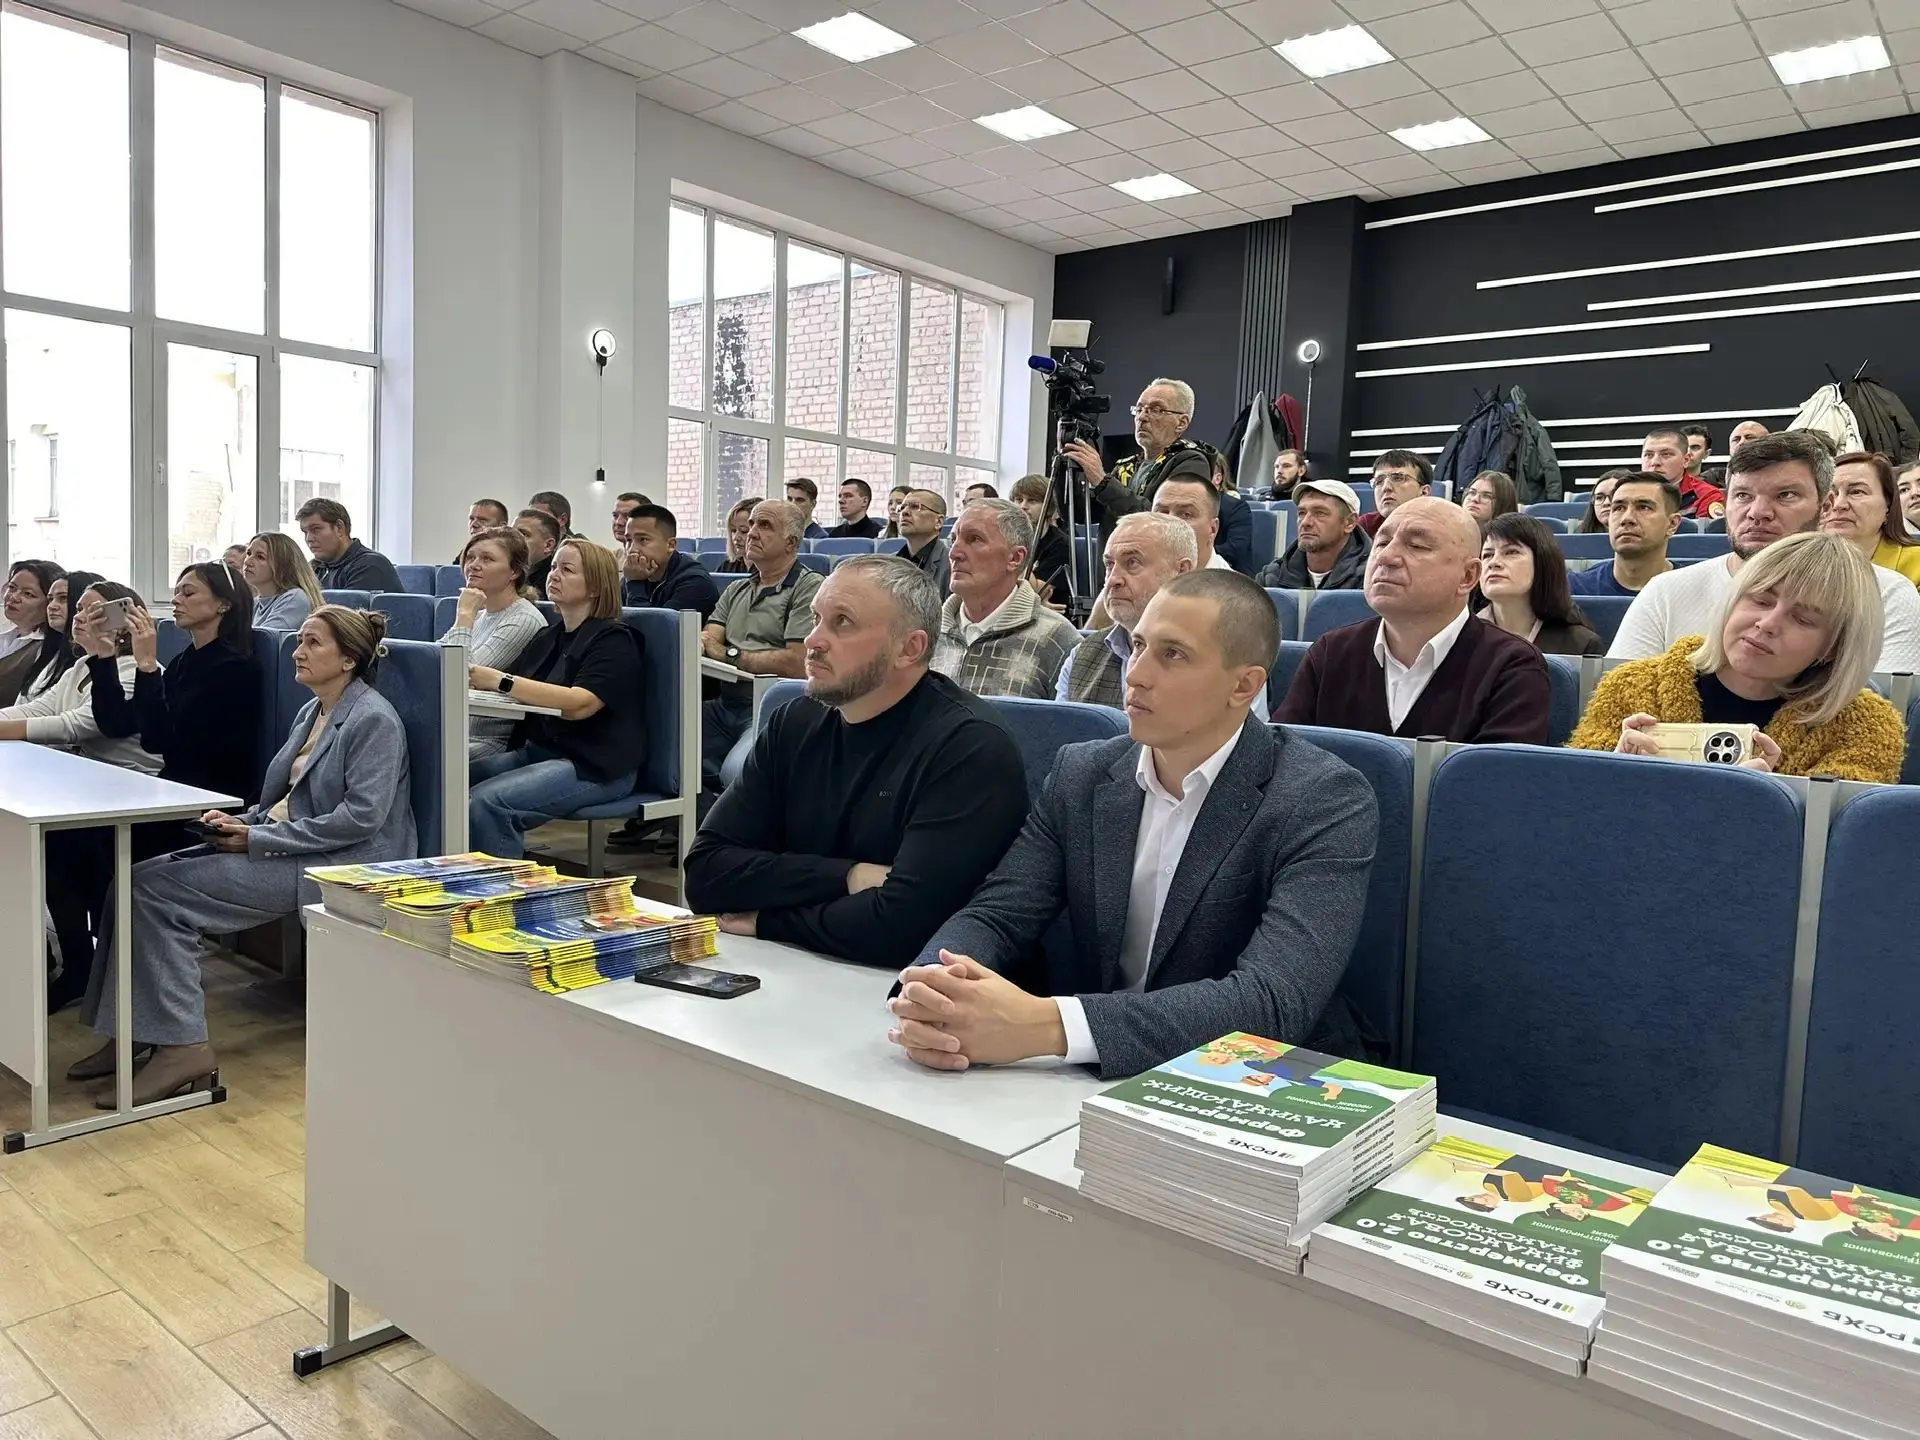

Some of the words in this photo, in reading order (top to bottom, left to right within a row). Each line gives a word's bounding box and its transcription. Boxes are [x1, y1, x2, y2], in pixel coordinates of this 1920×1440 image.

[1141, 1079, 1346, 1129] НАЧИНАЮЩИХ
[1142, 1095, 1306, 1137] Фермерство
[1228, 1137, 1278, 1157] РСХБ
[1356, 1218, 1405, 1236] 2.0
[1387, 1212, 1584, 1269] ФИНАНСОВАЯ
[1408, 1207, 1582, 1256] ГРАМОТНОСТЬ
[1647, 1239, 1705, 1259] 2.0
[1407, 1230, 1589, 1286] Фермерство
[1678, 1232, 1920, 1297] ФИНАНСОВАЯ
[1698, 1227, 1916, 1283] ГРАМОТНОСТЬ
[1483, 1279, 1550, 1306] РСХБ
[1822, 1310, 1907, 1341] РСХБ
